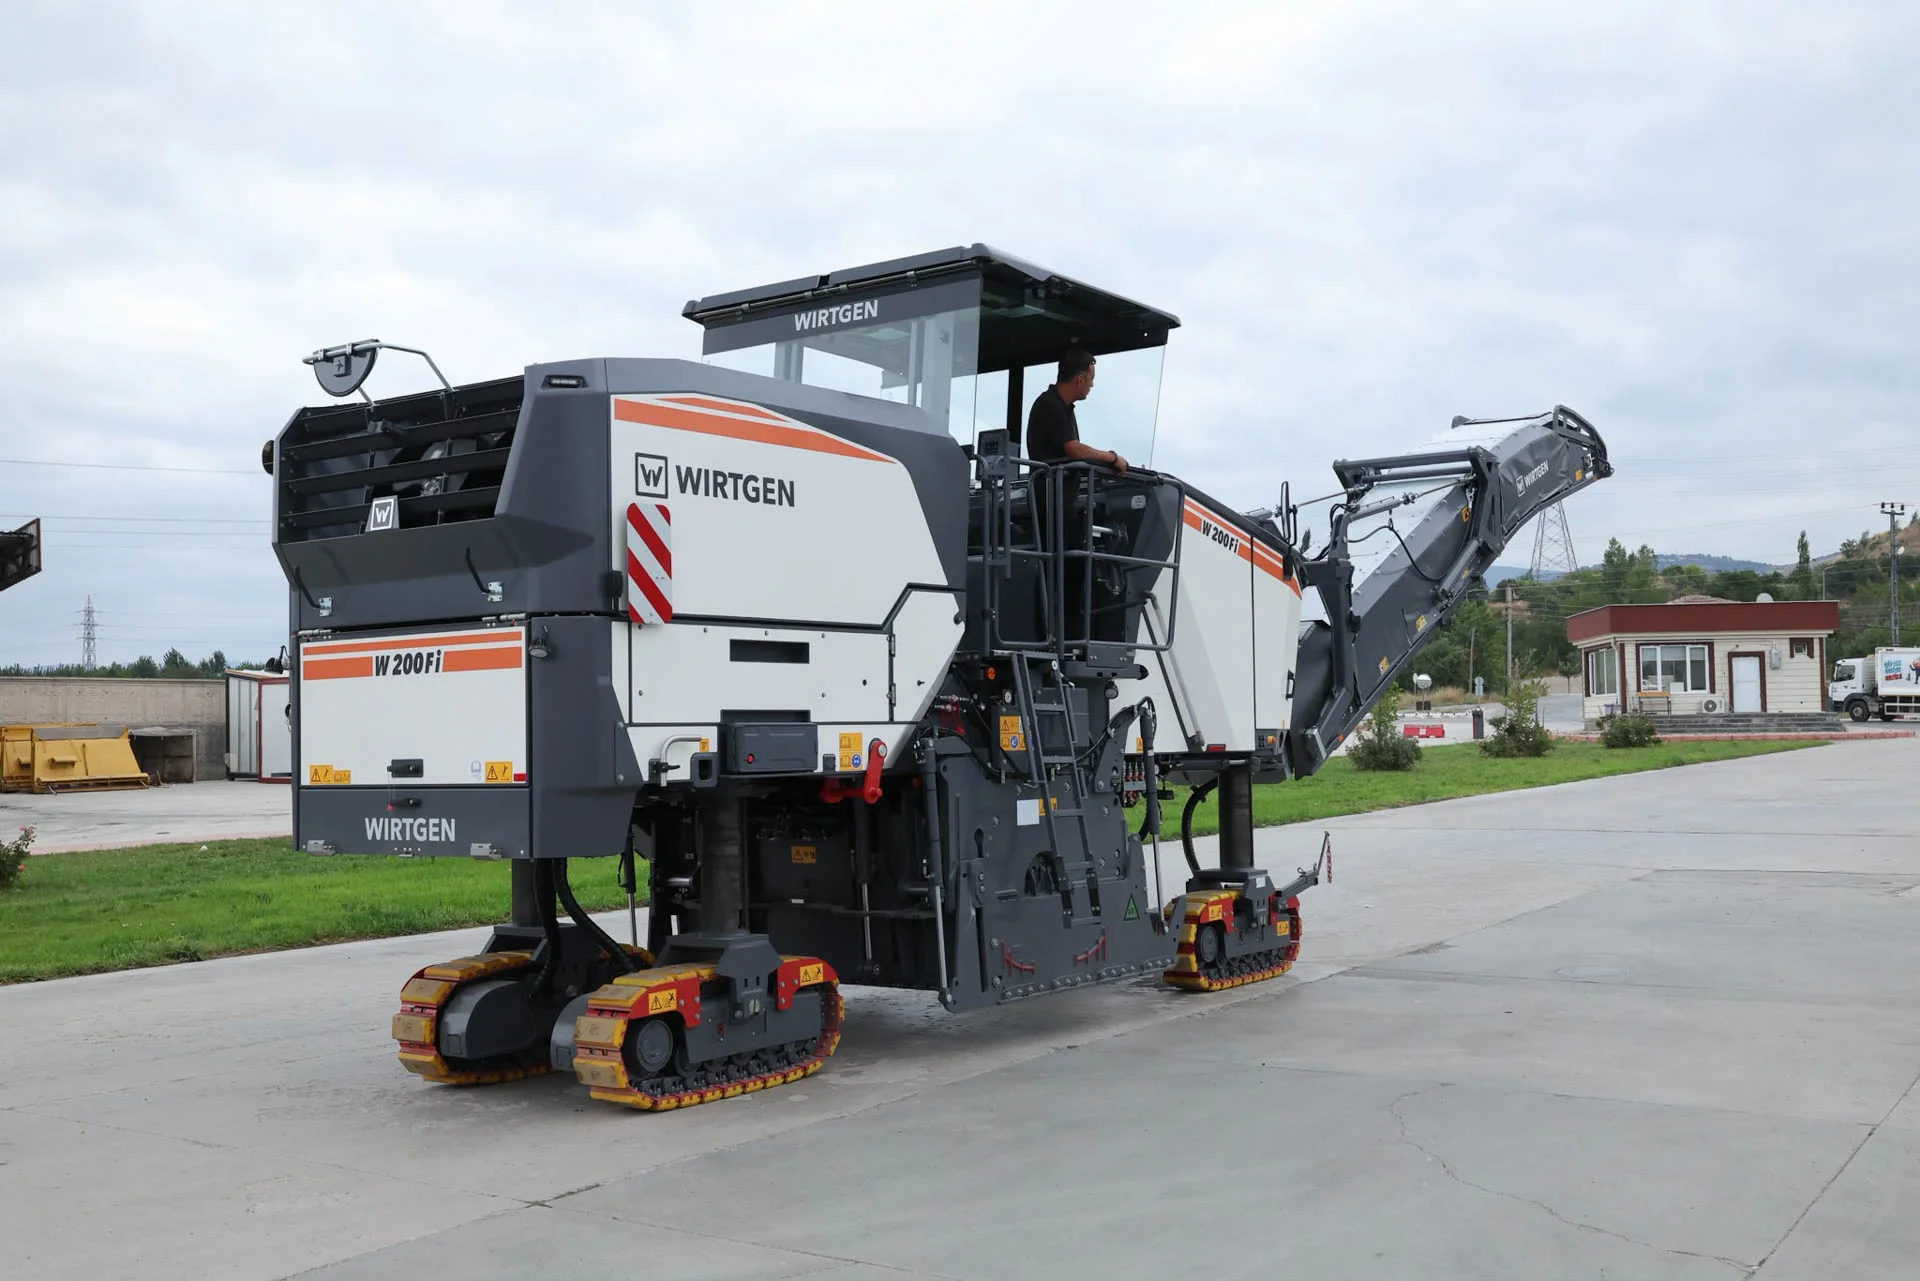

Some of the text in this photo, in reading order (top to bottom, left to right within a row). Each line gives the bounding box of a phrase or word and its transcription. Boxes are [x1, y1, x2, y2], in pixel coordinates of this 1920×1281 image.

[794, 299, 879, 331] WIRTGEN
[675, 464, 795, 508] WIRTGEN
[1523, 459, 1549, 488] WIRTGEN
[1202, 519, 1239, 554] W 200Fi
[375, 649, 442, 677] W 200Fi
[364, 817, 456, 842] WIRTGEN
